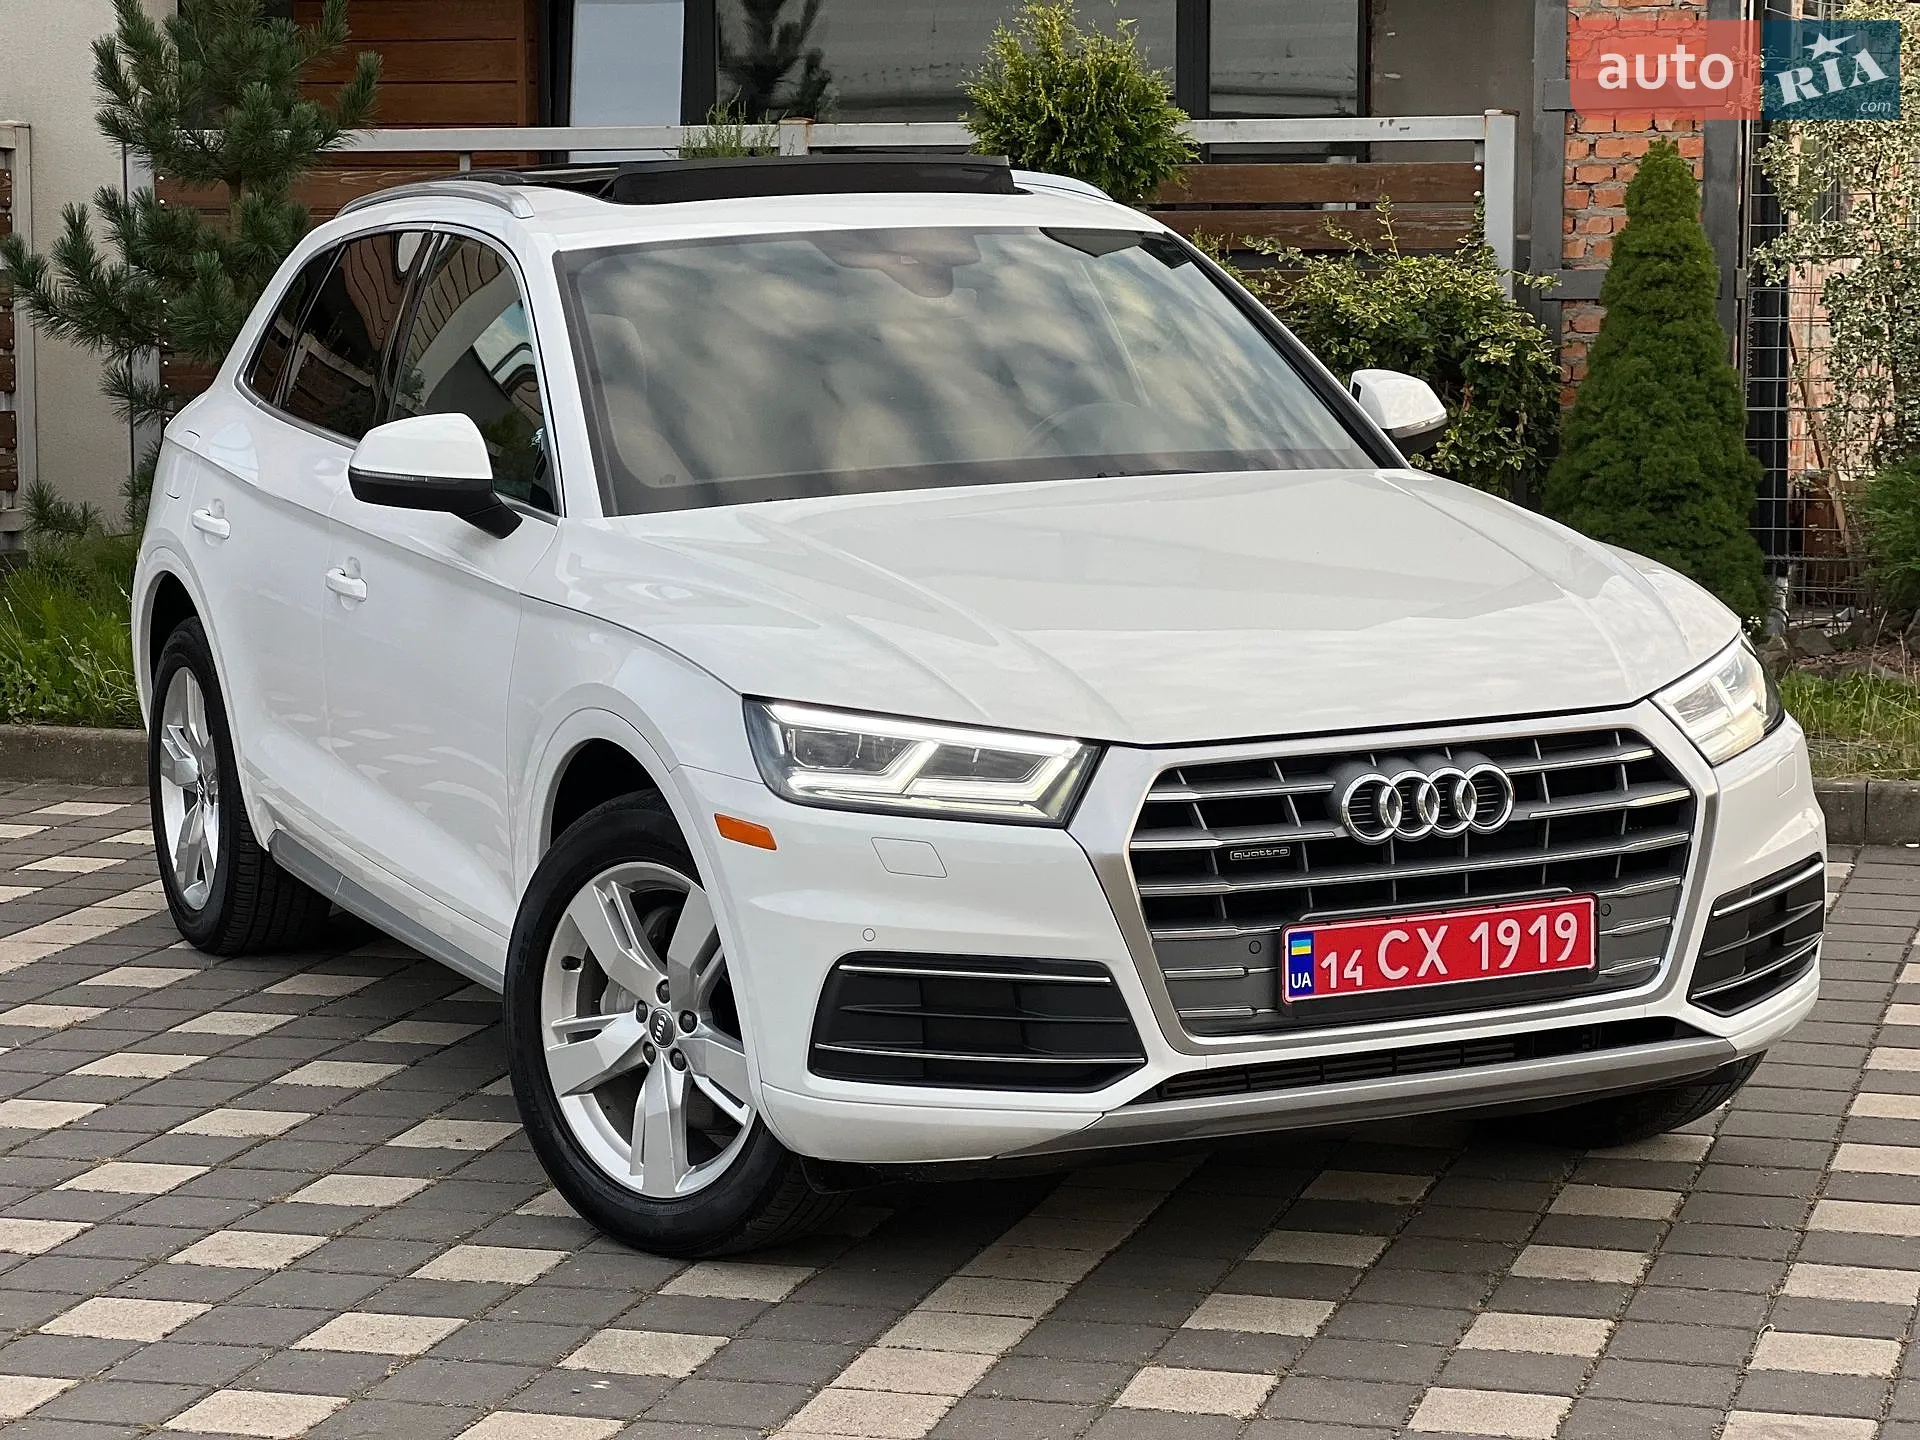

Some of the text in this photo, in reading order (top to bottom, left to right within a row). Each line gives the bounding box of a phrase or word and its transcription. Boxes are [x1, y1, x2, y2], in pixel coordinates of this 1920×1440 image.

[1233, 848, 1288, 859] quattro
[1320, 912, 1578, 989] 14 CX 1919
[1291, 972, 1312, 989] UA
